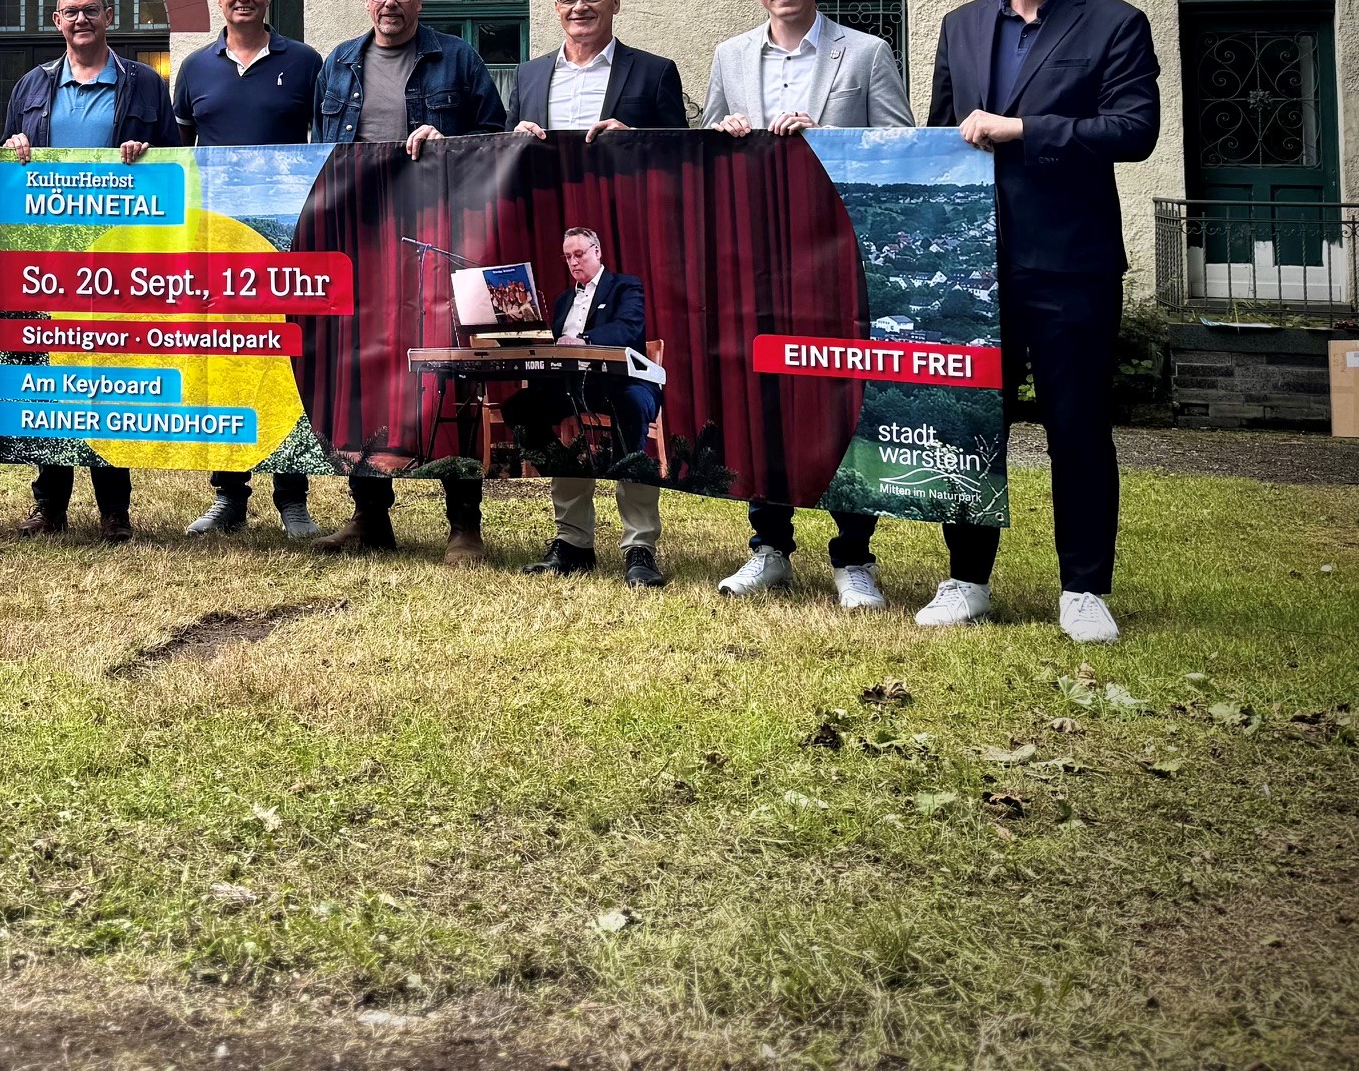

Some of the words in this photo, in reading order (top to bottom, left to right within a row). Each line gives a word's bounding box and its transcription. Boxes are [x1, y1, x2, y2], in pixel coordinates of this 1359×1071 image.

[26, 172, 134, 188] KulturHerbst
[25, 190, 164, 216] MÖHNETAL
[23, 266, 64, 295] So.
[76, 268, 119, 295] 20.
[130, 268, 209, 303] Sept.,
[223, 268, 256, 295] 12
[268, 268, 329, 296] Uhr
[23, 326, 128, 350] Sichtigvor
[147, 329, 281, 351] Ostwaldpark
[785, 344, 903, 373] EINTRITT
[913, 352, 971, 377] FREI
[21, 374, 55, 392] Am
[63, 374, 161, 397] Keyboard
[21, 410, 99, 430] RAINER
[106, 412, 244, 434] GRUNDHOFF
[879, 423, 937, 444] stadt
[879, 445, 979, 471] warstein
[880, 484, 910, 497] Mitten
[913, 487, 925, 497] im
[929, 489, 981, 503] Naturpark
